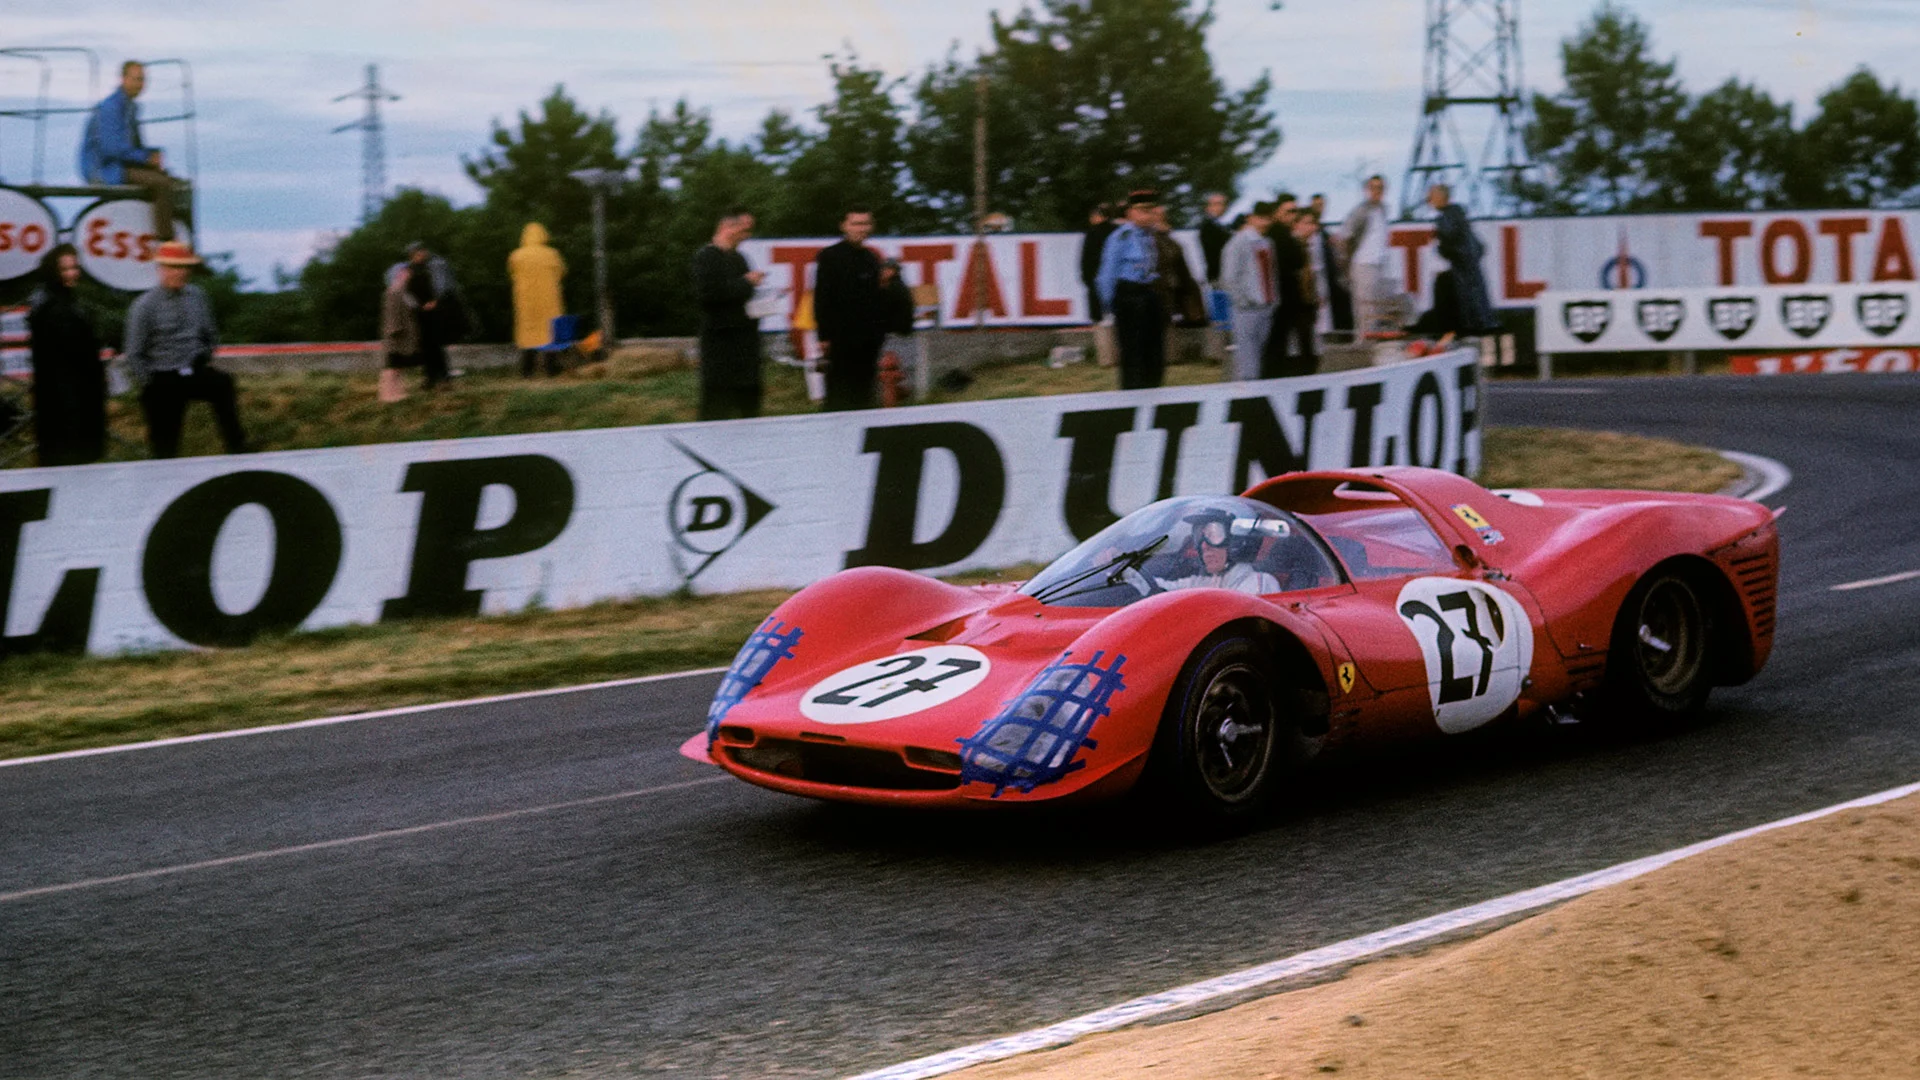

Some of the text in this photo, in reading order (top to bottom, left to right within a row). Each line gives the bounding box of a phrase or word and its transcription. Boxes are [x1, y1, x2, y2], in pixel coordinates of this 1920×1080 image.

[87, 219, 155, 262] Ess
[771, 241, 1071, 320] TTAL
[687, 496, 732, 532] D
[1400, 590, 1494, 705] 27
[812, 655, 982, 708] 27
